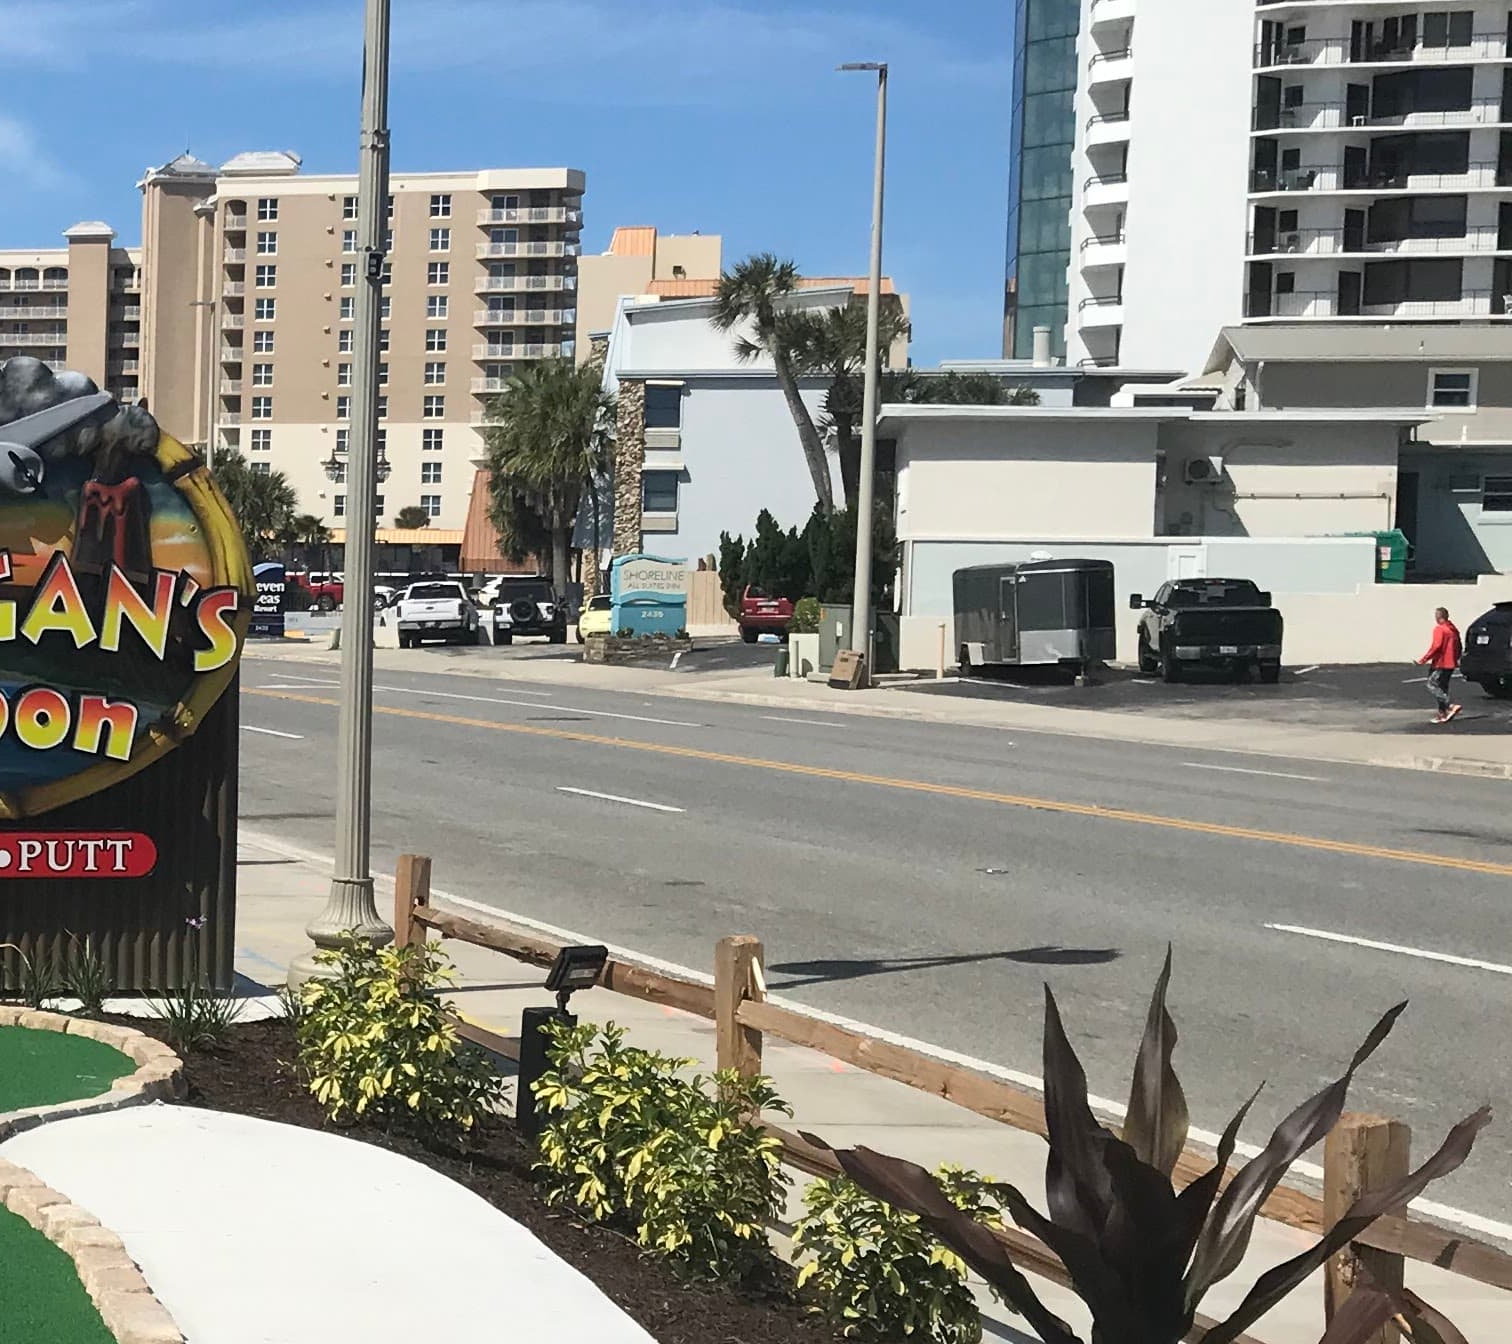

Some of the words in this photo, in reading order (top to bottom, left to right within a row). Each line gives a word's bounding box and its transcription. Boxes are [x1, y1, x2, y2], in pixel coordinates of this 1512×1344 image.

[623, 570, 685, 581] SHORELINE
[256, 582, 285, 592] even
[257, 594, 281, 604] eas
[18, 838, 133, 872] PUTT
